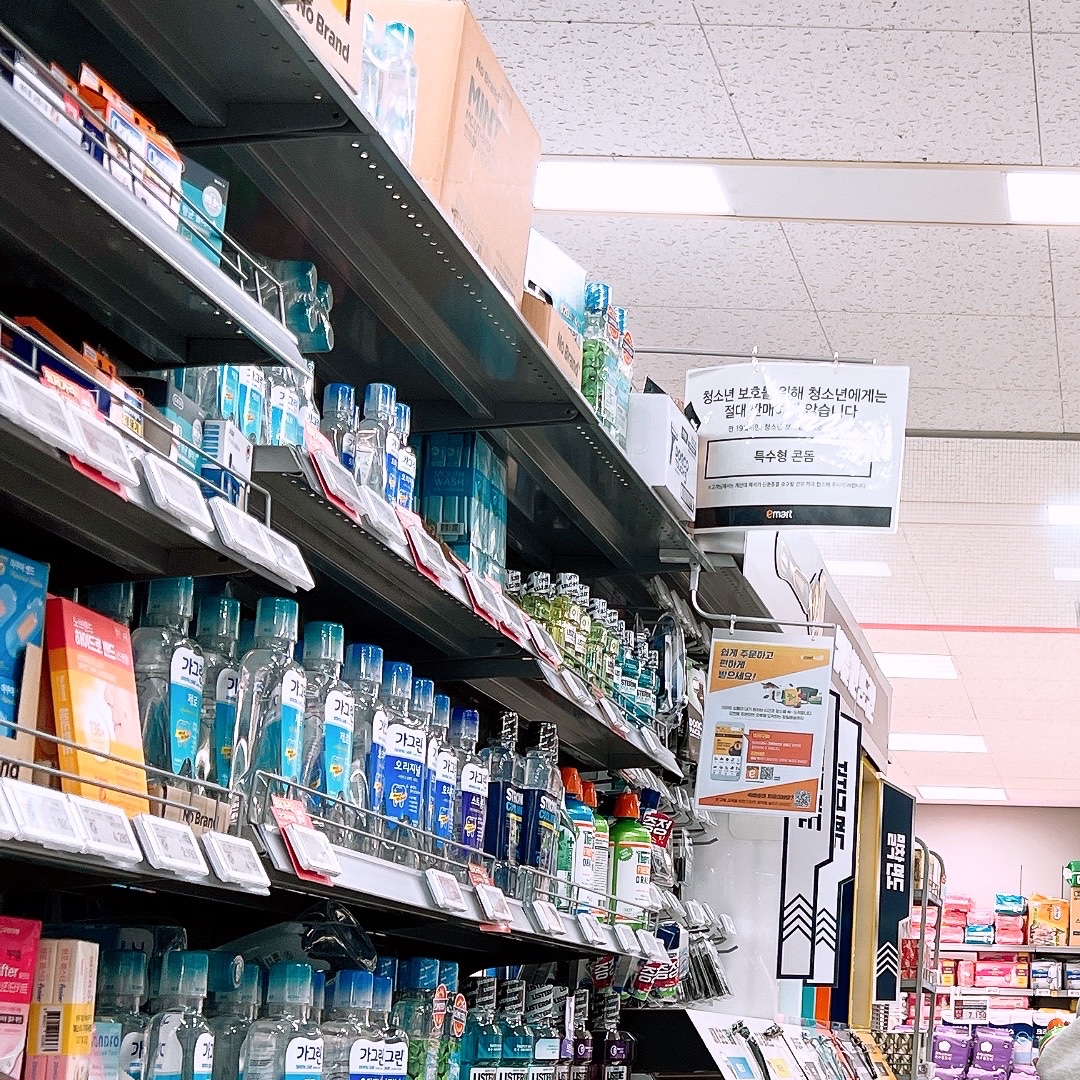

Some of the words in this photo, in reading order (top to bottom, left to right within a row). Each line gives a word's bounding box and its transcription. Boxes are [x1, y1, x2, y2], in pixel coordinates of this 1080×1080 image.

[316, 13, 350, 63] Brand
[703, 388, 735, 405] 청소년
[808, 387, 888, 404] 청소년에게는
[724, 404, 747, 419] 절대
[754, 450, 788, 463] 특수형
[791, 450, 815, 463] 콘돔
[766, 508, 793, 520] emart
[720, 648, 738, 659] 쉽게
[740, 649, 774, 660] 주문하고
[719, 659, 746, 670] 편하게
[718, 671, 757, 682] 받으세요!
[396, 732, 424, 754] 가그린
[394, 759, 422, 778] 오리지널
[643, 815, 672, 837] 증정
[886, 832, 906, 862] 밀착
[886, 862, 905, 893] 면도
[0, 963, 19, 979] fter
[384, 1048, 404, 1067] 그린
